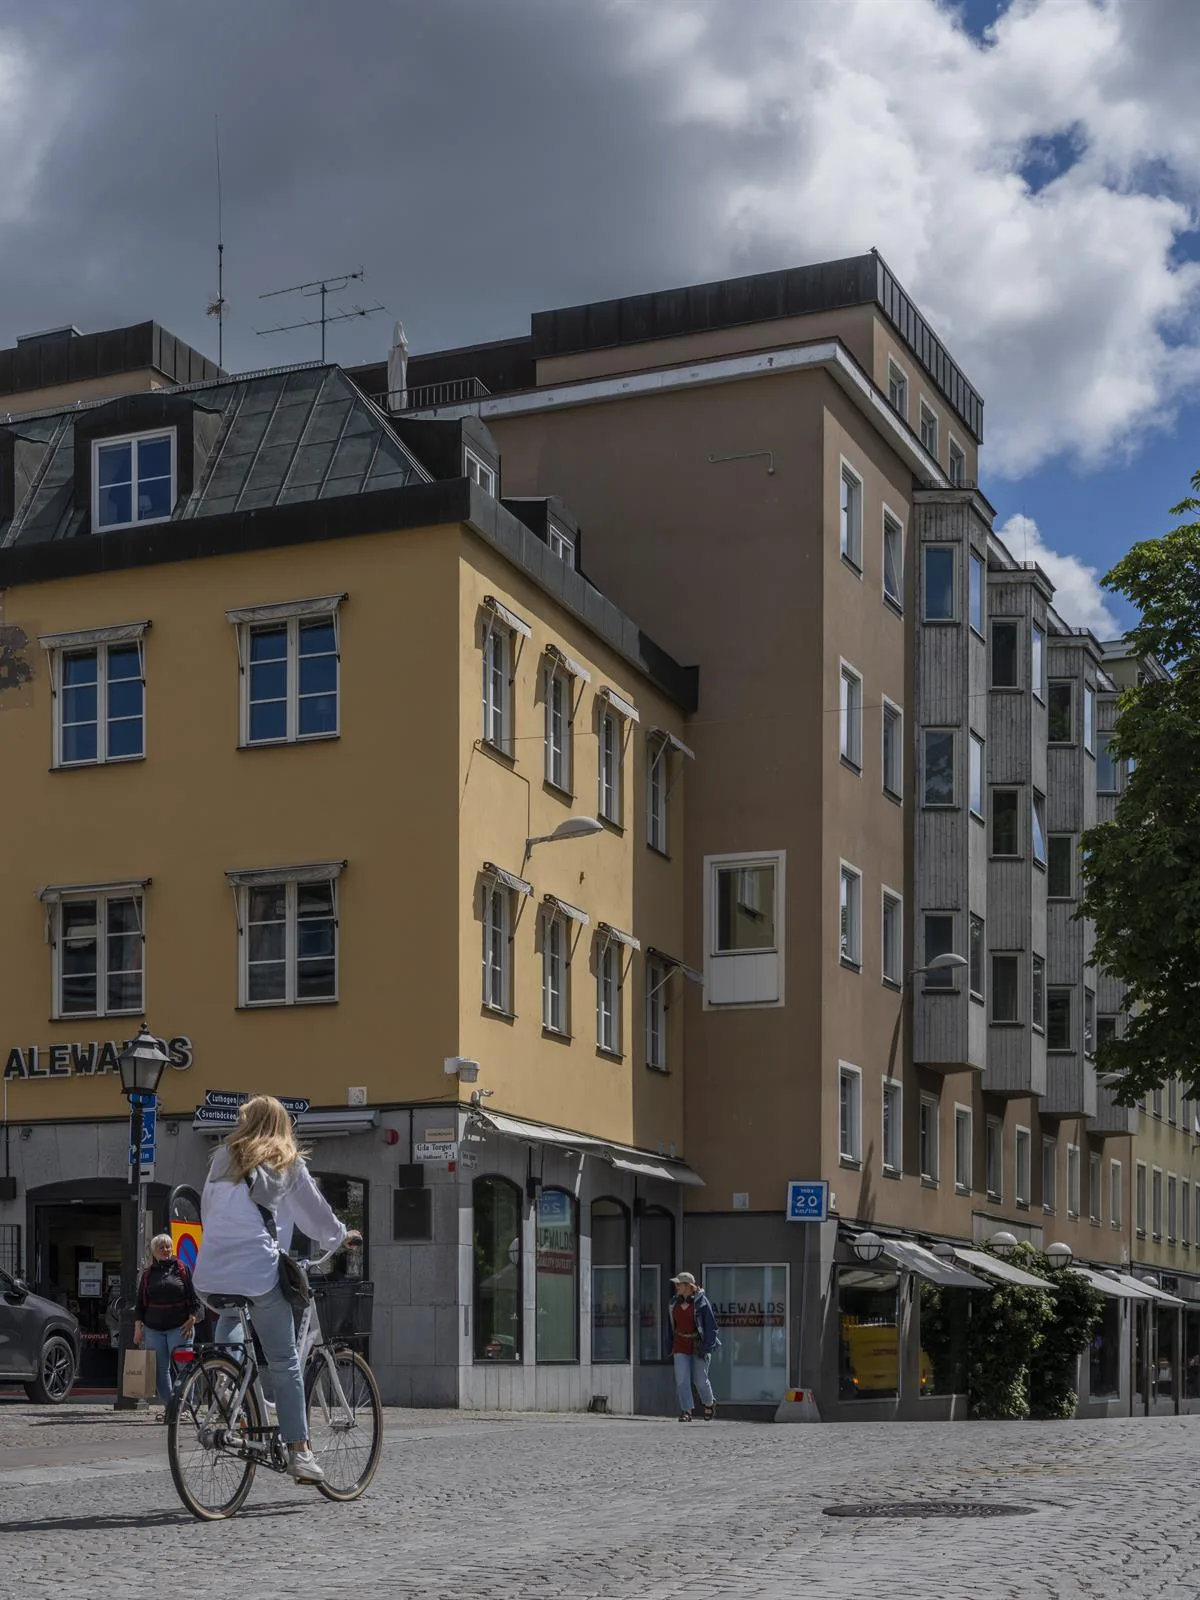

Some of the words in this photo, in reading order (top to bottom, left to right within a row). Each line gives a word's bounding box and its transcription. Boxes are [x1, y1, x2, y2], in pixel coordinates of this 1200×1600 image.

[4, 1036, 192, 1079] ALEWAS
[212, 1094, 237, 1104] Luthagen
[201, 1110, 237, 1120] Svartbäcken
[796, 1195, 818, 1207] 20
[712, 1302, 785, 1314] ALEWALDS
